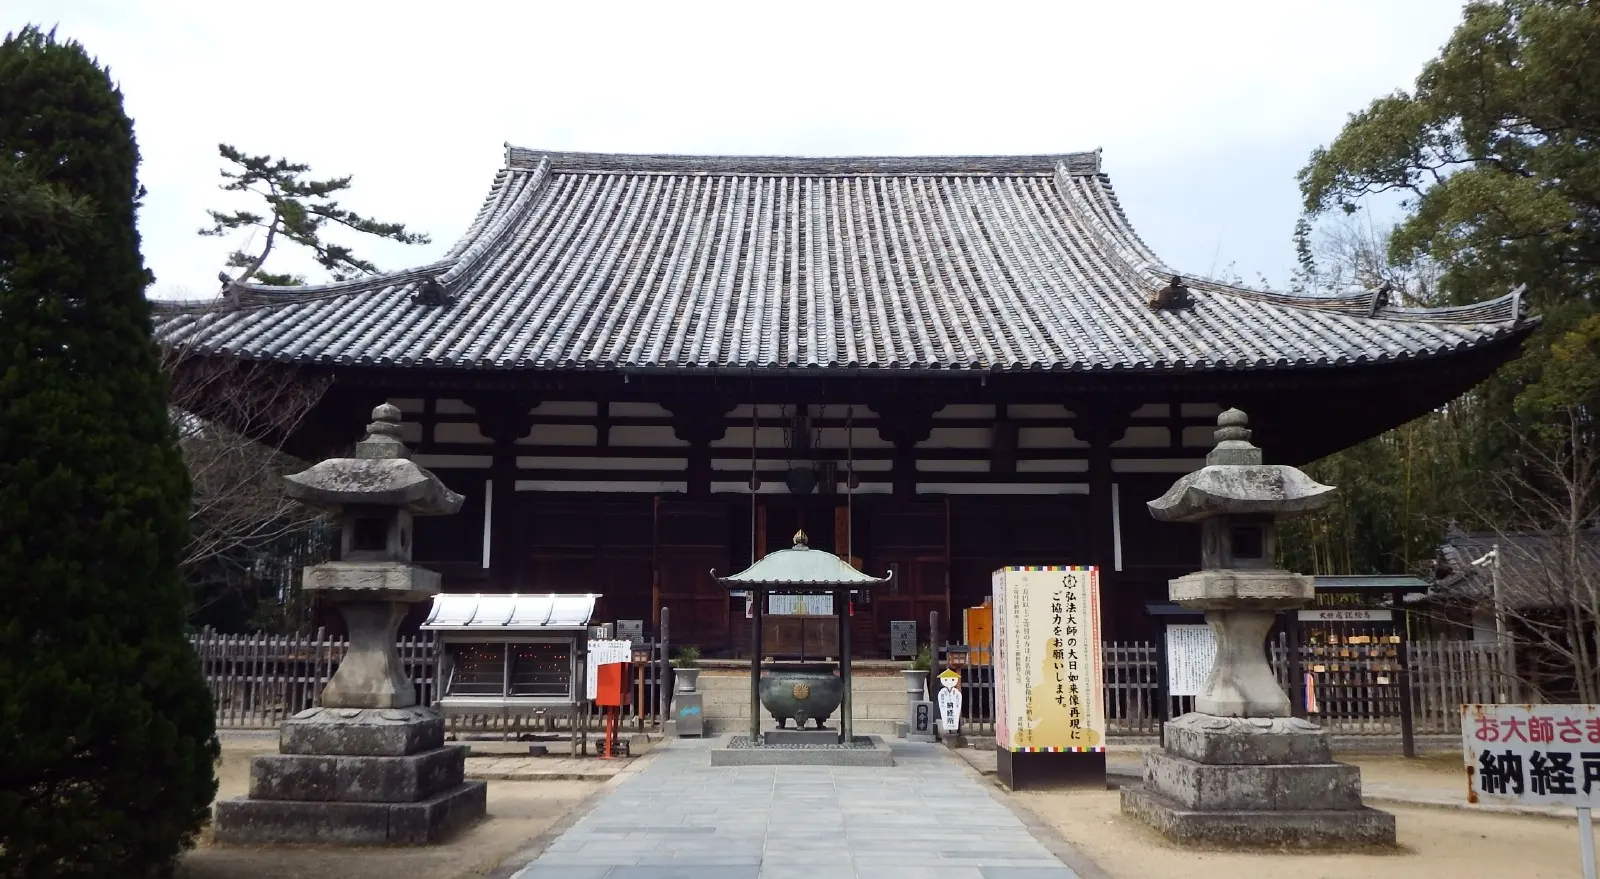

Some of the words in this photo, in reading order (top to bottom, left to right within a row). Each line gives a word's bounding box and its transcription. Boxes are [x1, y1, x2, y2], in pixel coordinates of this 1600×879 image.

[1052, 590, 1066, 708] ご協力をお願いします。
[1066, 592, 1081, 740] 弘法大師の大日如来像再現に
